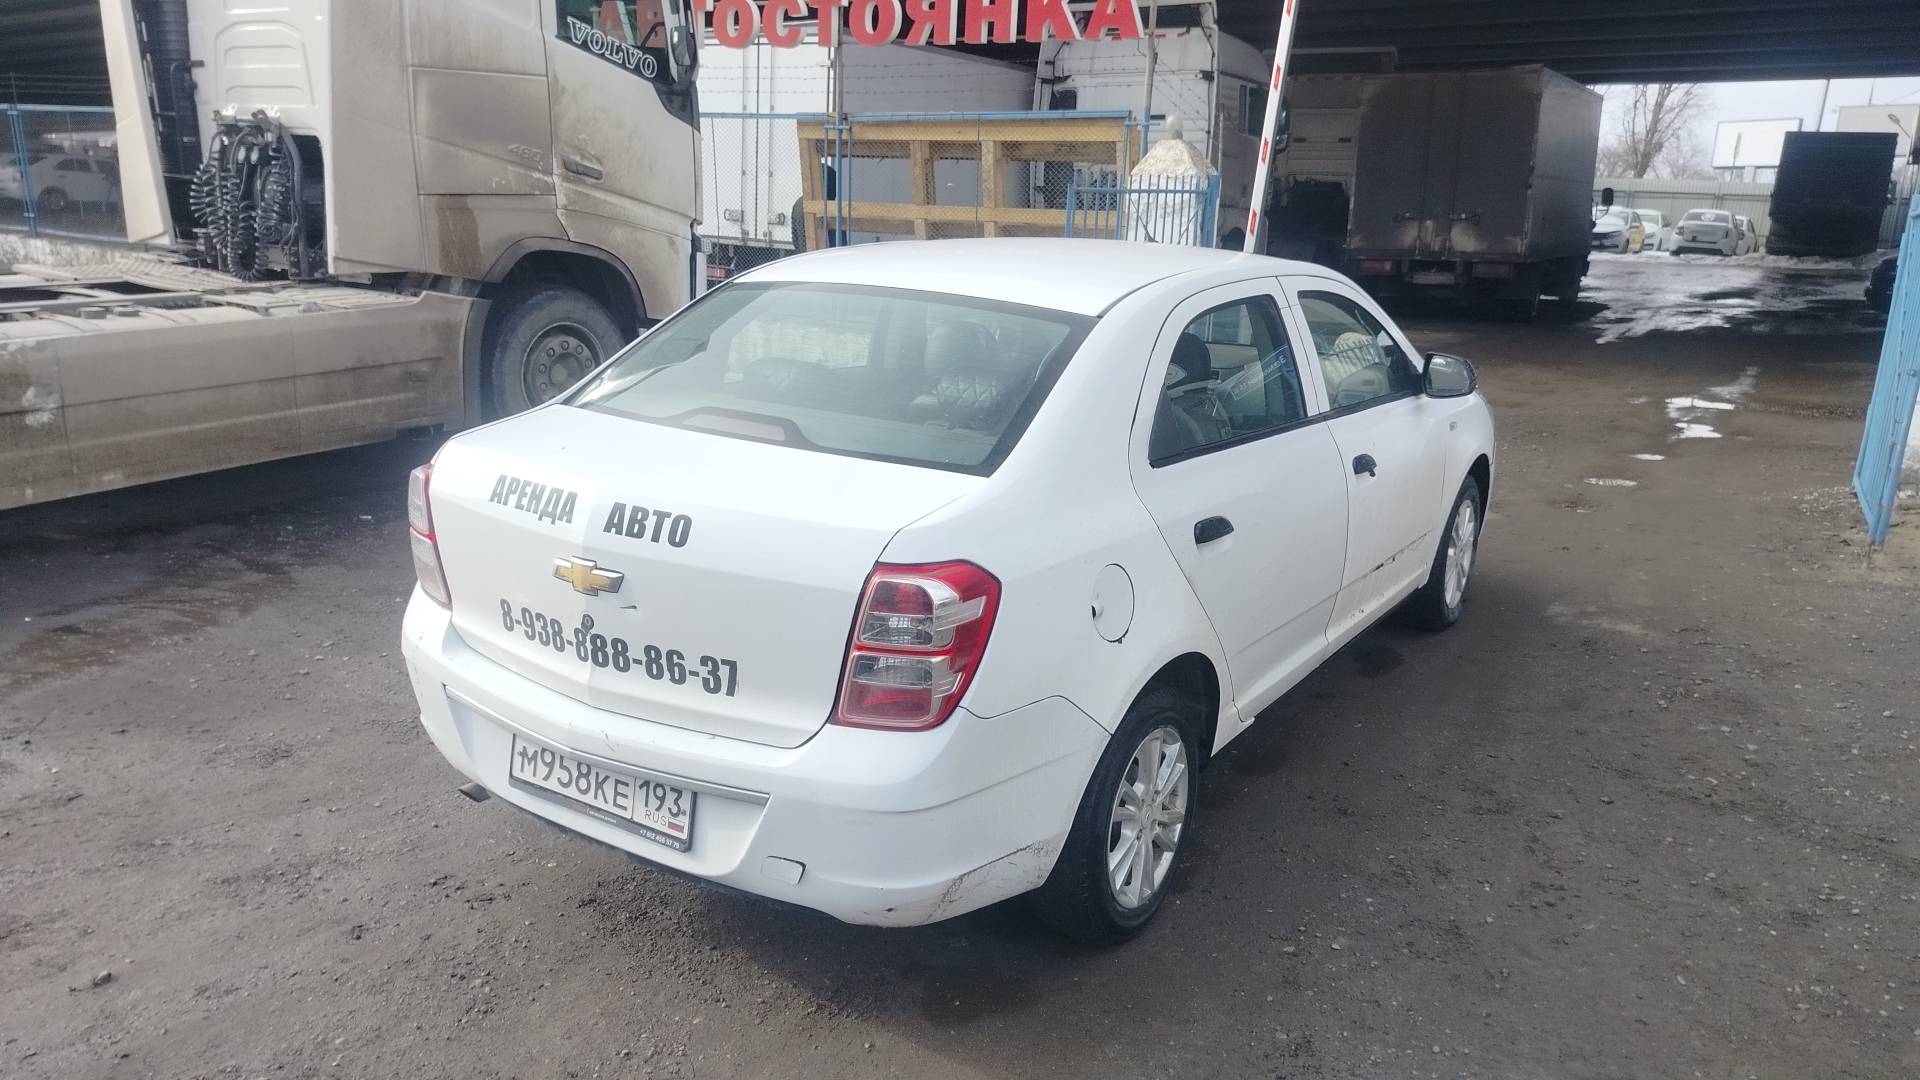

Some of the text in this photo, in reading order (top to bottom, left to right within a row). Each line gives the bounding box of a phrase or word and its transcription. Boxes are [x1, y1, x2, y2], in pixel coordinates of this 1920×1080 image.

[567, 16, 657, 78] VOLVO
[488, 473, 692, 548] АРЕНДА АВТО
[500, 598, 738, 697] 8-938-888-86-37
[517, 746, 684, 818] М958КЕ 193
[644, 810, 667, 826] RUS
